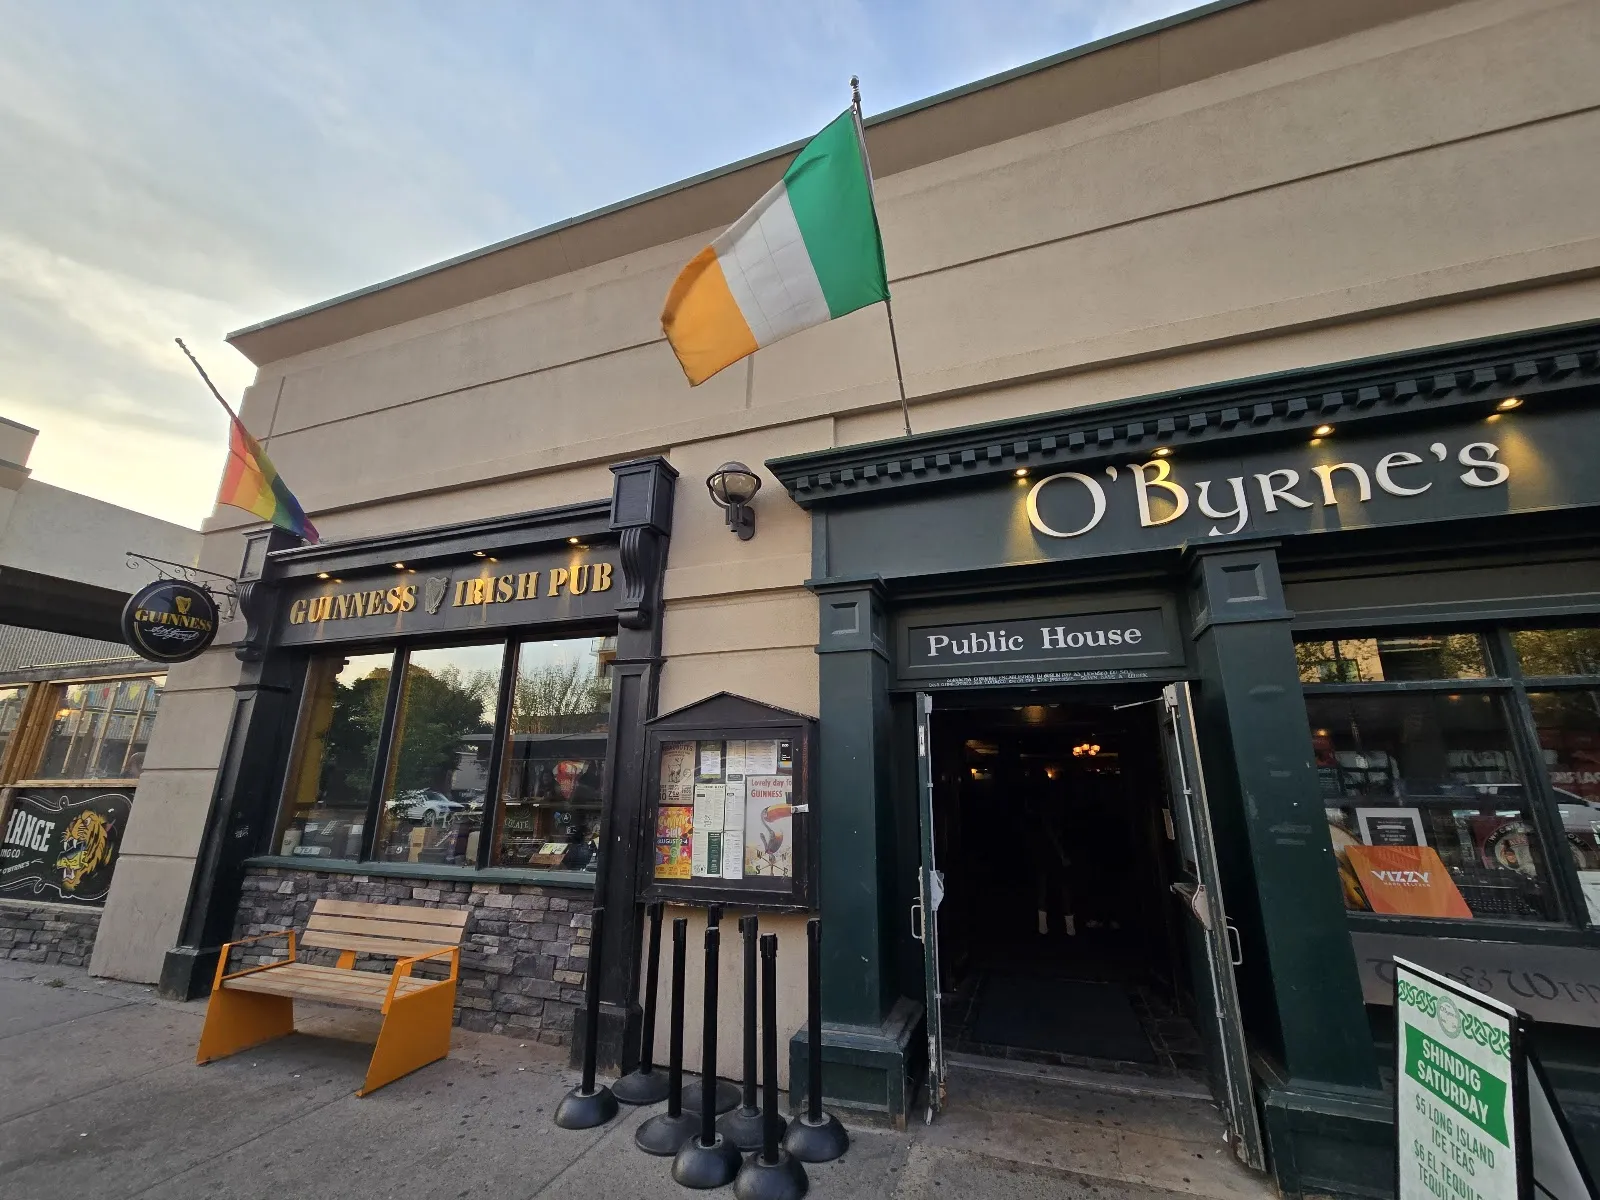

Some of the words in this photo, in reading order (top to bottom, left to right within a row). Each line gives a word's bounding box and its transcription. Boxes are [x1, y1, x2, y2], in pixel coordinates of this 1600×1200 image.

[288, 585, 418, 625] GUINNESS
[451, 571, 541, 608] IRISH
[546, 562, 615, 597] PUB
[134, 608, 213, 632] GUINNESS
[926, 629, 1024, 657] Public
[1040, 626, 1143, 650] House
[751, 778, 771, 788] Lovely
[772, 778, 785, 788] day
[751, 789, 783, 798] GUINNESS
[1371, 870, 1429, 883] VIZZY
[1422, 1038, 1481, 1092] SHINDIG
[1417, 1059, 1489, 1125] SATURDAY
[1415, 1093, 1426, 1115] $5
[1428, 1103, 1453, 1137] LONG
[1456, 1124, 1495, 1170] ISLAND
[1414, 1138, 1425, 1161] $6
[1427, 1151, 1438, 1175] EL
[1431, 1126, 1447, 1154] ICE
[1449, 1141, 1475, 1177] TEAS
